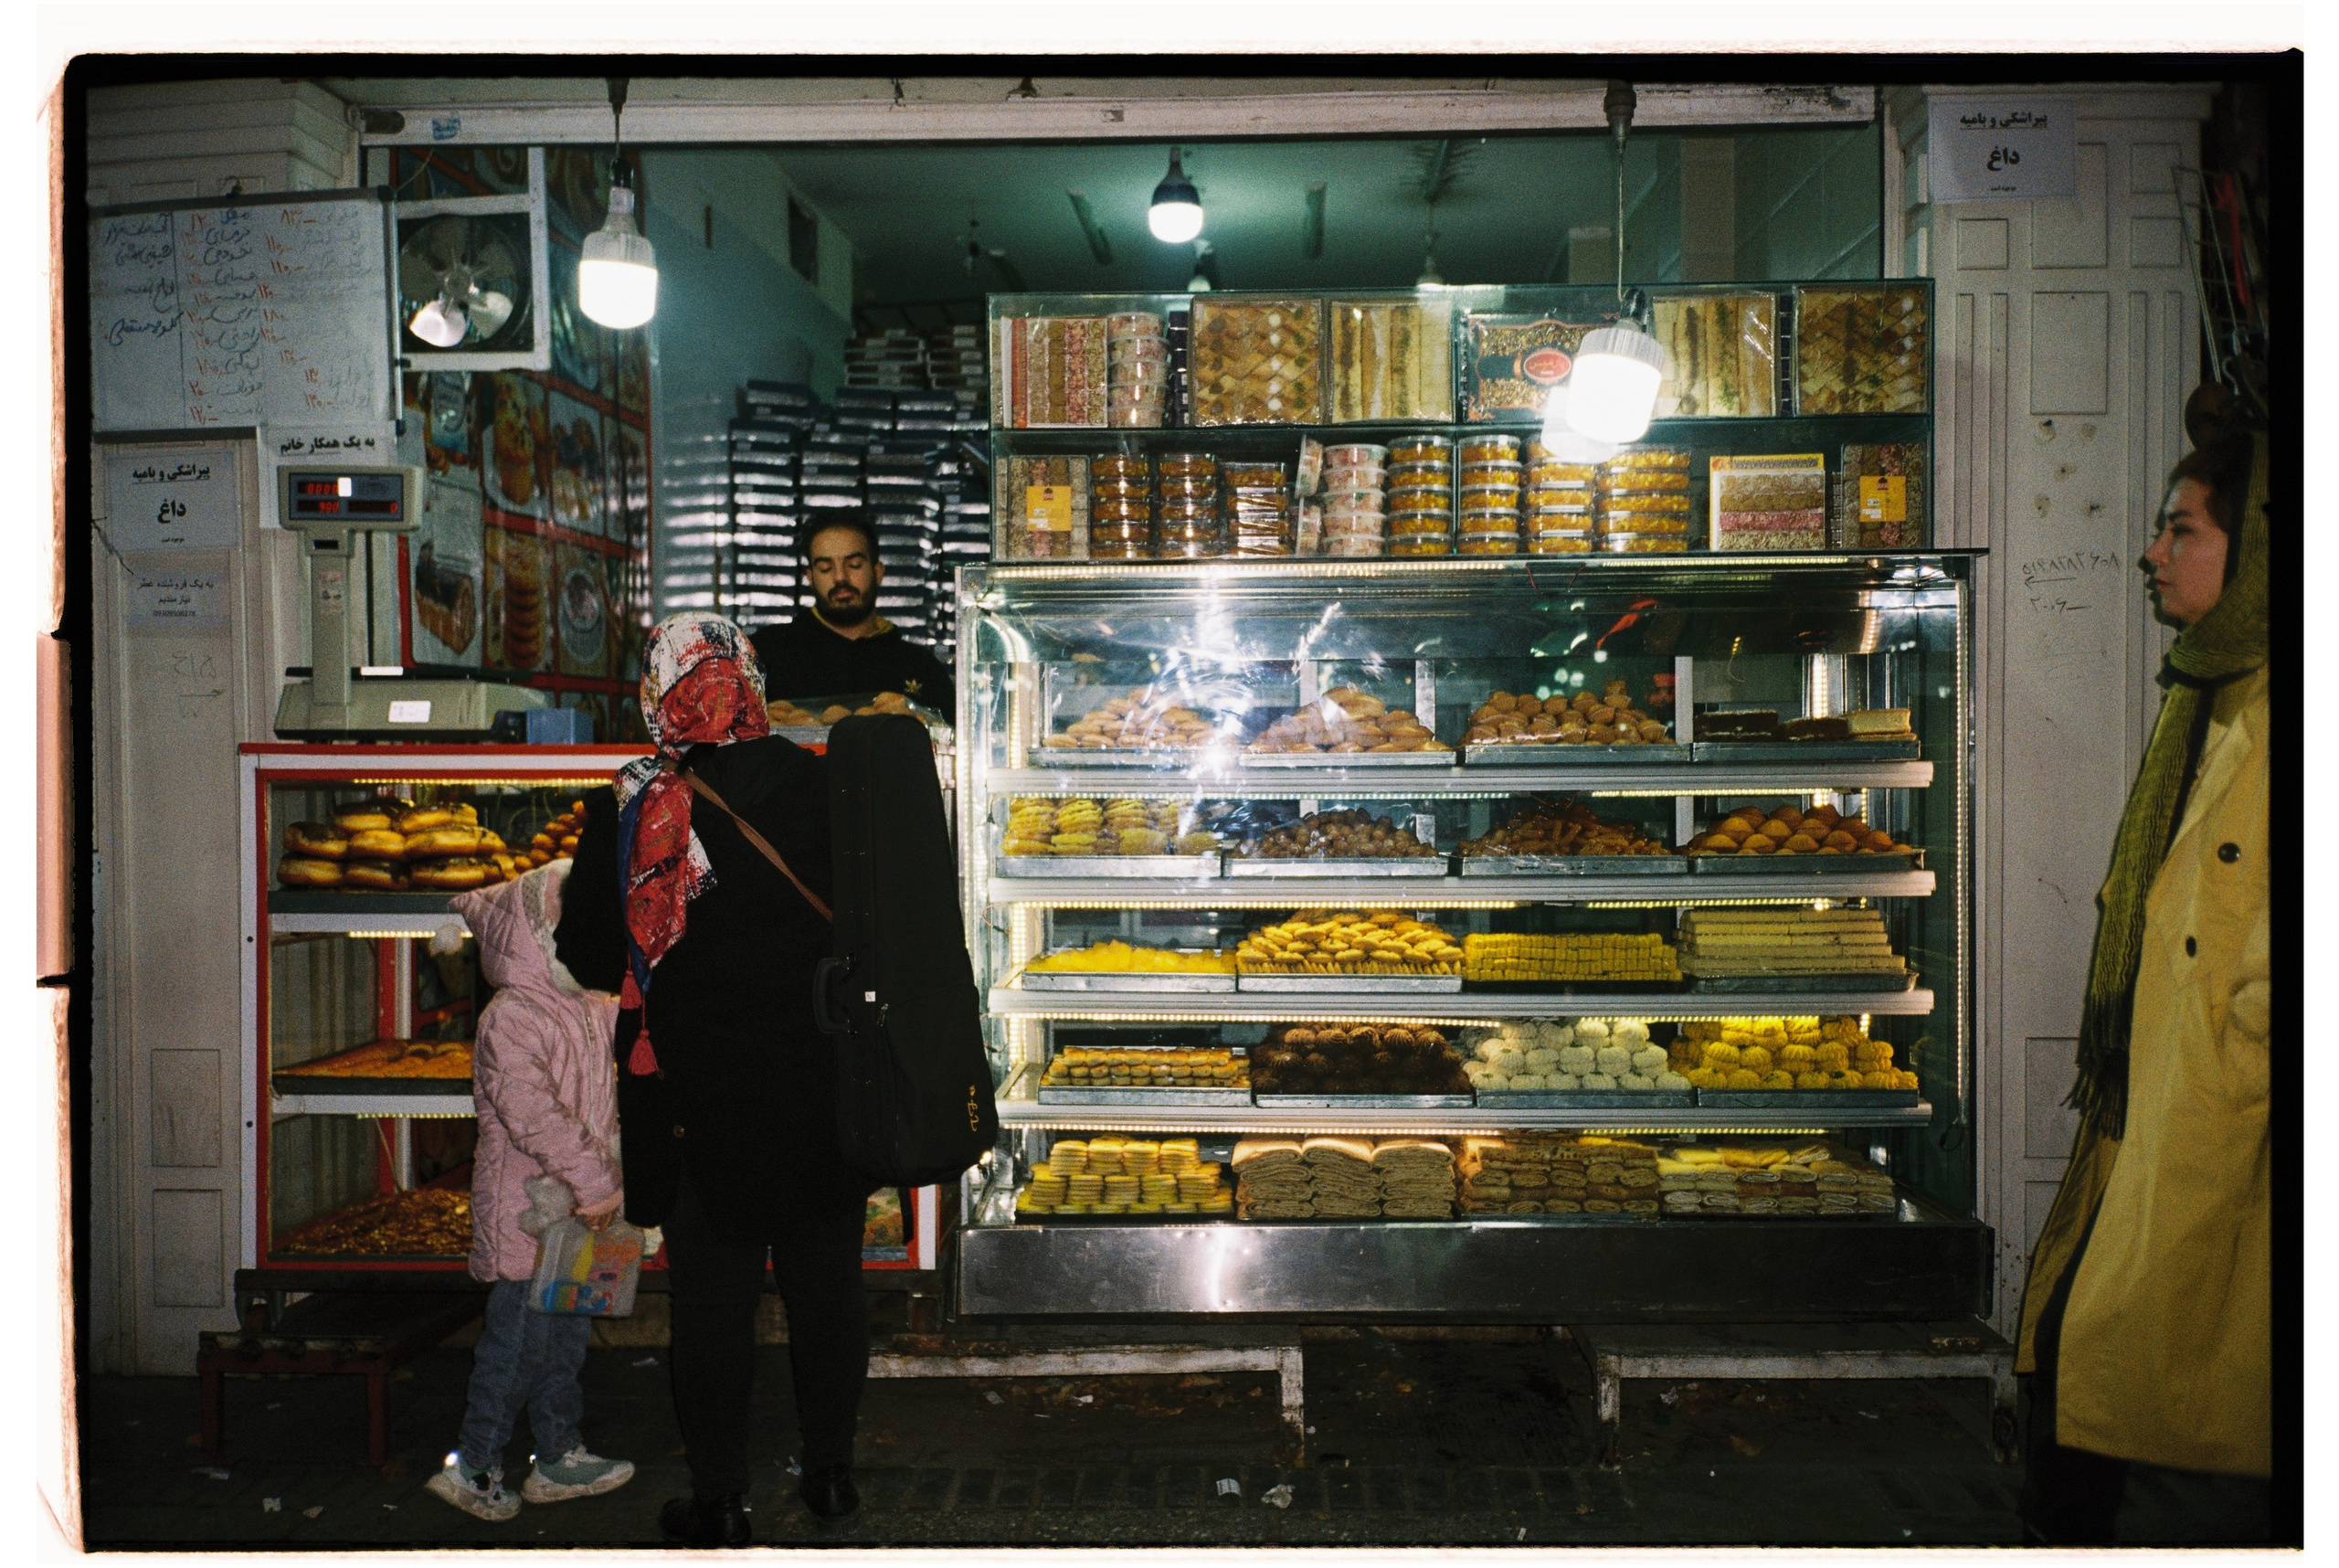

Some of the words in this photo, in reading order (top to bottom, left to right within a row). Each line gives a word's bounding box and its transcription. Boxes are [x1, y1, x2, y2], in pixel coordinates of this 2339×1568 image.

[1960, 112, 1986, 127] بامیه
[1990, 116, 1997, 129] و
[1999, 111, 2048, 129] پیراشکی
[1986, 144, 2020, 172] داغ
[280, 439, 303, 454] خانم
[309, 438, 340, 454] همکار
[343, 435, 361, 450] یک
[365, 438, 376, 450] به
[132, 466, 156, 481] بامیه
[159, 470, 165, 482] و
[167, 463, 211, 481] پیراشکی
[157, 498, 186, 524] داغ
